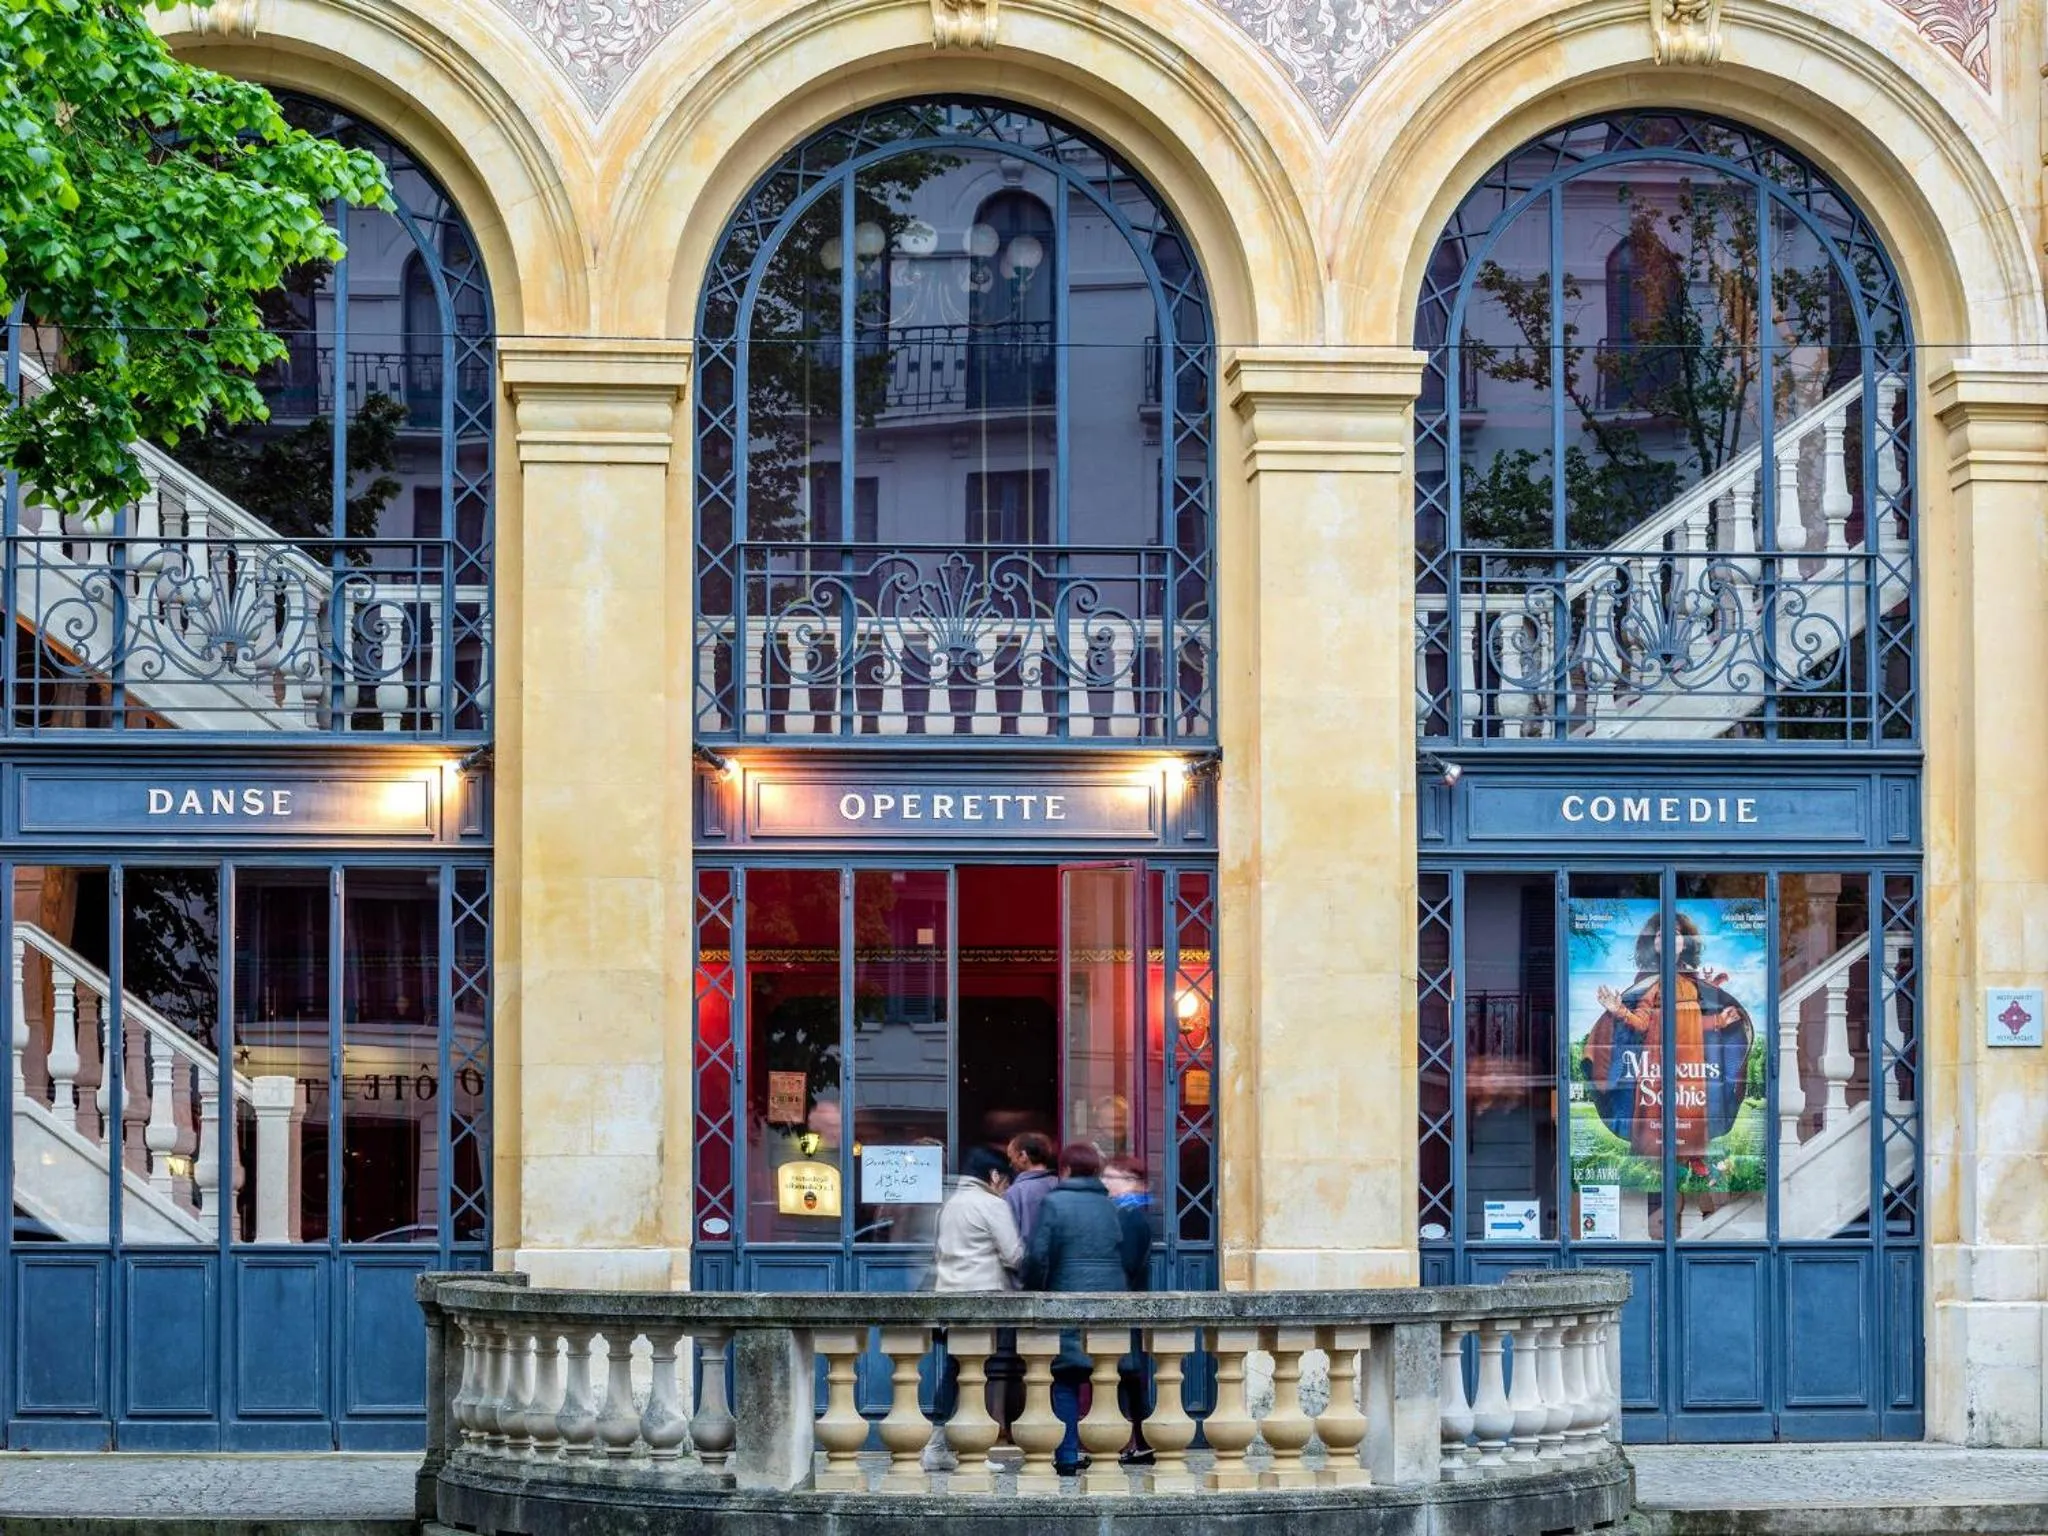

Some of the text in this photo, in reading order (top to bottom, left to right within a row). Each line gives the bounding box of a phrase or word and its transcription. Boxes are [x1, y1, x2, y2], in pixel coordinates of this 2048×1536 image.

[148, 788, 293, 816] DANSE
[839, 793, 1067, 820] OPERETTE
[1561, 795, 1758, 823] COMEDIE
